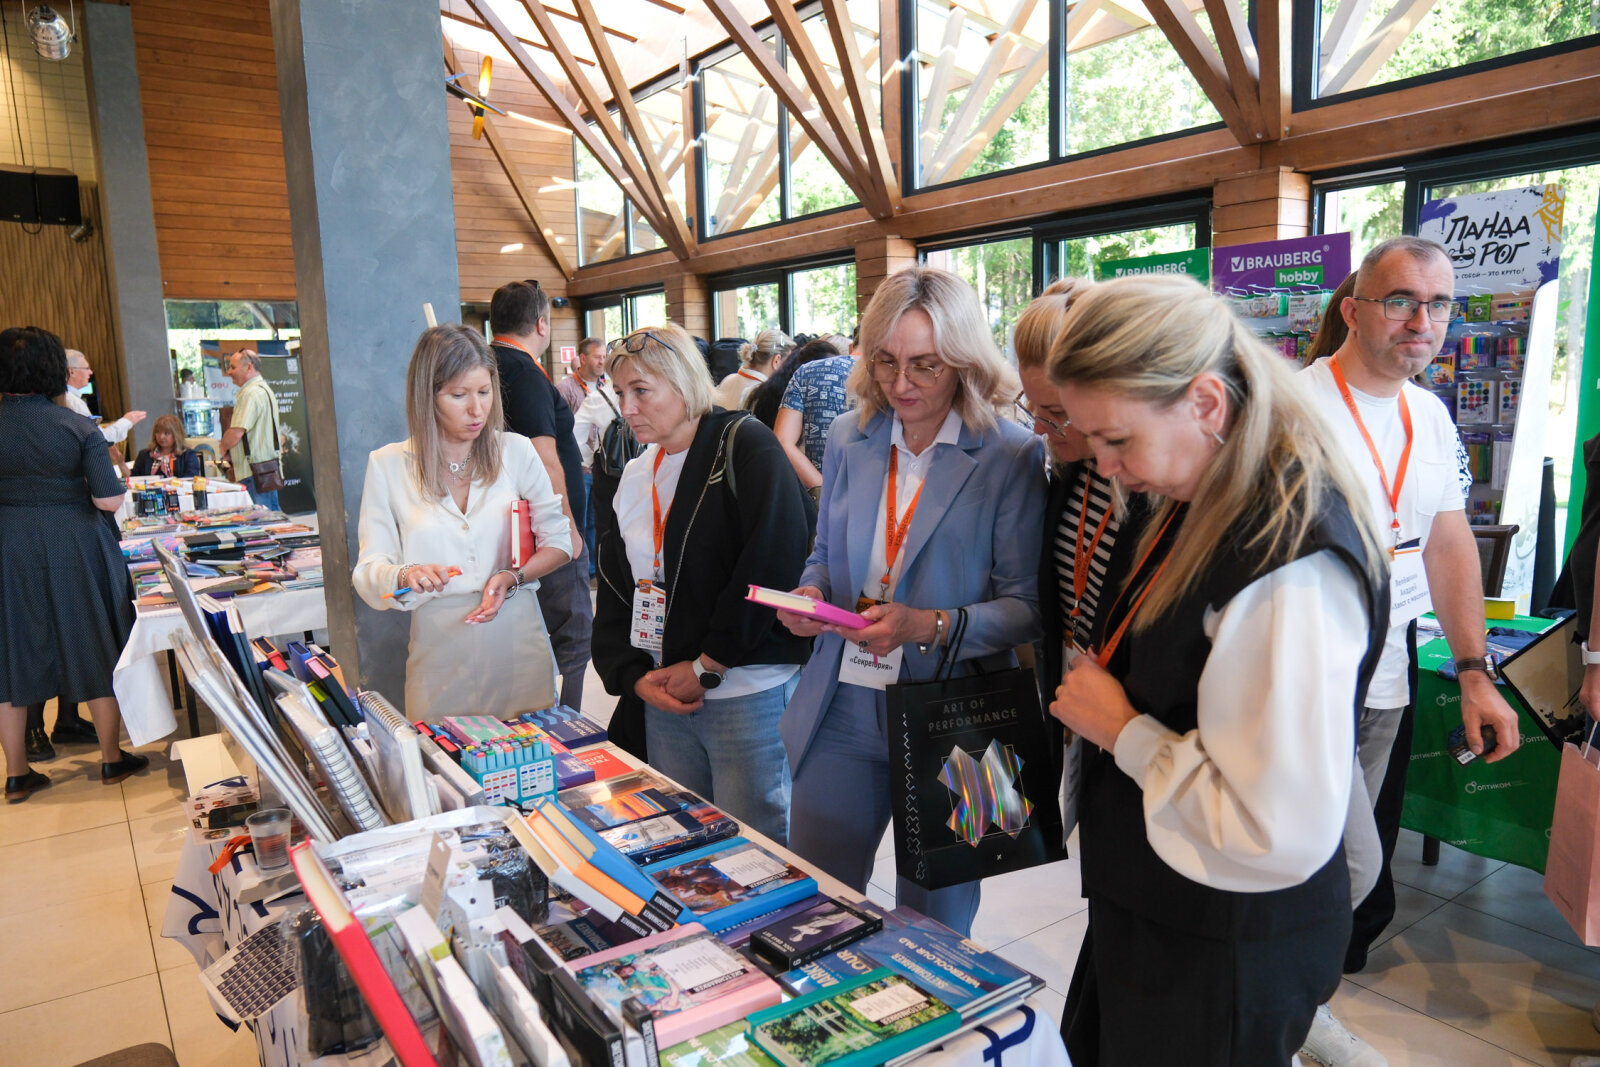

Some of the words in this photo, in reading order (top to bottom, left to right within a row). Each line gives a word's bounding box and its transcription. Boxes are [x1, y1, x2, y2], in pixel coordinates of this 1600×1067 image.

[1445, 211, 1530, 244] ПАНДА
[1247, 250, 1322, 271] BRAUBERG
[1479, 241, 1530, 266] РОГ
[1279, 269, 1319, 286] hobby
[1488, 270, 1499, 278] ЭТО
[1501, 267, 1525, 276] КРУТО!
[943, 701, 964, 714] ART
[970, 698, 985, 710] OF
[928, 708, 1018, 732] PERFORMANCE
[1477, 782, 1511, 791] ОПТИКОМ
[654, 895, 678, 915] SKETCHMARKER
[620, 917, 648, 936] SKETCHMARKER
[643, 909, 669, 931] SKETCHMARKER
[575, 922, 608, 950] TCHMARKER
[899, 937, 918, 953] PAD
[837, 950, 872, 975] LOUR
[890, 952, 948, 989] SKETCHMARKER
[916, 946, 980, 989] WATERCOLOUR
[692, 969, 743, 993] SKETCHMARKER
[880, 1003, 928, 1025] SKETCHMARKER
